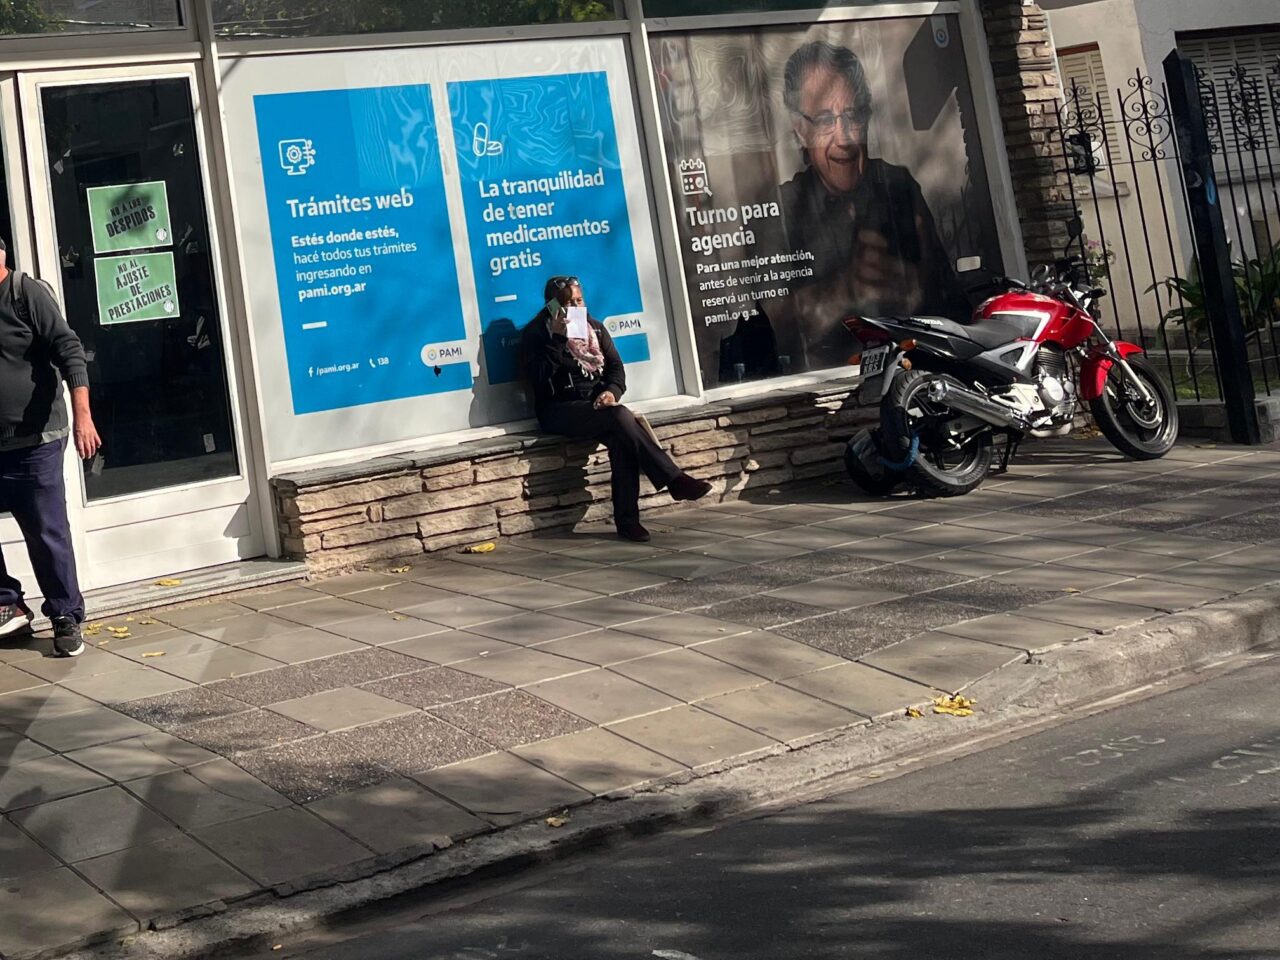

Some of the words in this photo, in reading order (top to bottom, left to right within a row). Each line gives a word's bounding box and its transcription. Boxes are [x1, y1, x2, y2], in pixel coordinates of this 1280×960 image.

[479, 179, 500, 198] La
[502, 167, 605, 196] tranquilidad
[110, 206, 120, 217] NO
[122, 203, 128, 212] A
[286, 193, 372, 218] Trámites
[375, 187, 414, 209] web
[482, 203, 505, 223] de
[507, 199, 555, 220] tener
[685, 206, 738, 227] Turno
[741, 201, 780, 225] para
[105, 205, 156, 238] DESPIDOS
[486, 218, 610, 248] medicamentos
[291, 232, 325, 248] Estés
[326, 228, 363, 244] donde
[365, 225, 399, 239] estés,
[691, 226, 756, 255] agencia
[293, 250, 319, 265] hacé
[321, 247, 352, 262] todos
[354, 246, 372, 258] tus
[373, 241, 417, 256] trámites
[489, 248, 542, 277] gratis
[696, 263, 720, 275] Para
[720, 261, 740, 271] una
[741, 255, 769, 269] mejor
[770, 249, 815, 264] atención,
[116, 265, 150, 290] AJUSTE
[118, 263, 128, 274] NO
[129, 258, 139, 269] AL
[296, 263, 356, 284] ingresando
[358, 264, 372, 275] en
[699, 279, 725, 291] antes
[726, 275, 738, 287] de
[739, 272, 761, 285] venir
[763, 273, 770, 282] a
[769, 269, 779, 281] la
[779, 266, 813, 281] agencia
[130, 282, 143, 297] DE
[298, 282, 367, 303] pami.org.ar
[701, 292, 736, 308] reservá
[737, 292, 750, 302] un
[750, 289, 777, 301] turno
[777, 287, 789, 297] en
[108, 284, 172, 321] PRESTACIONES
[439, 347, 462, 358] PAMI
